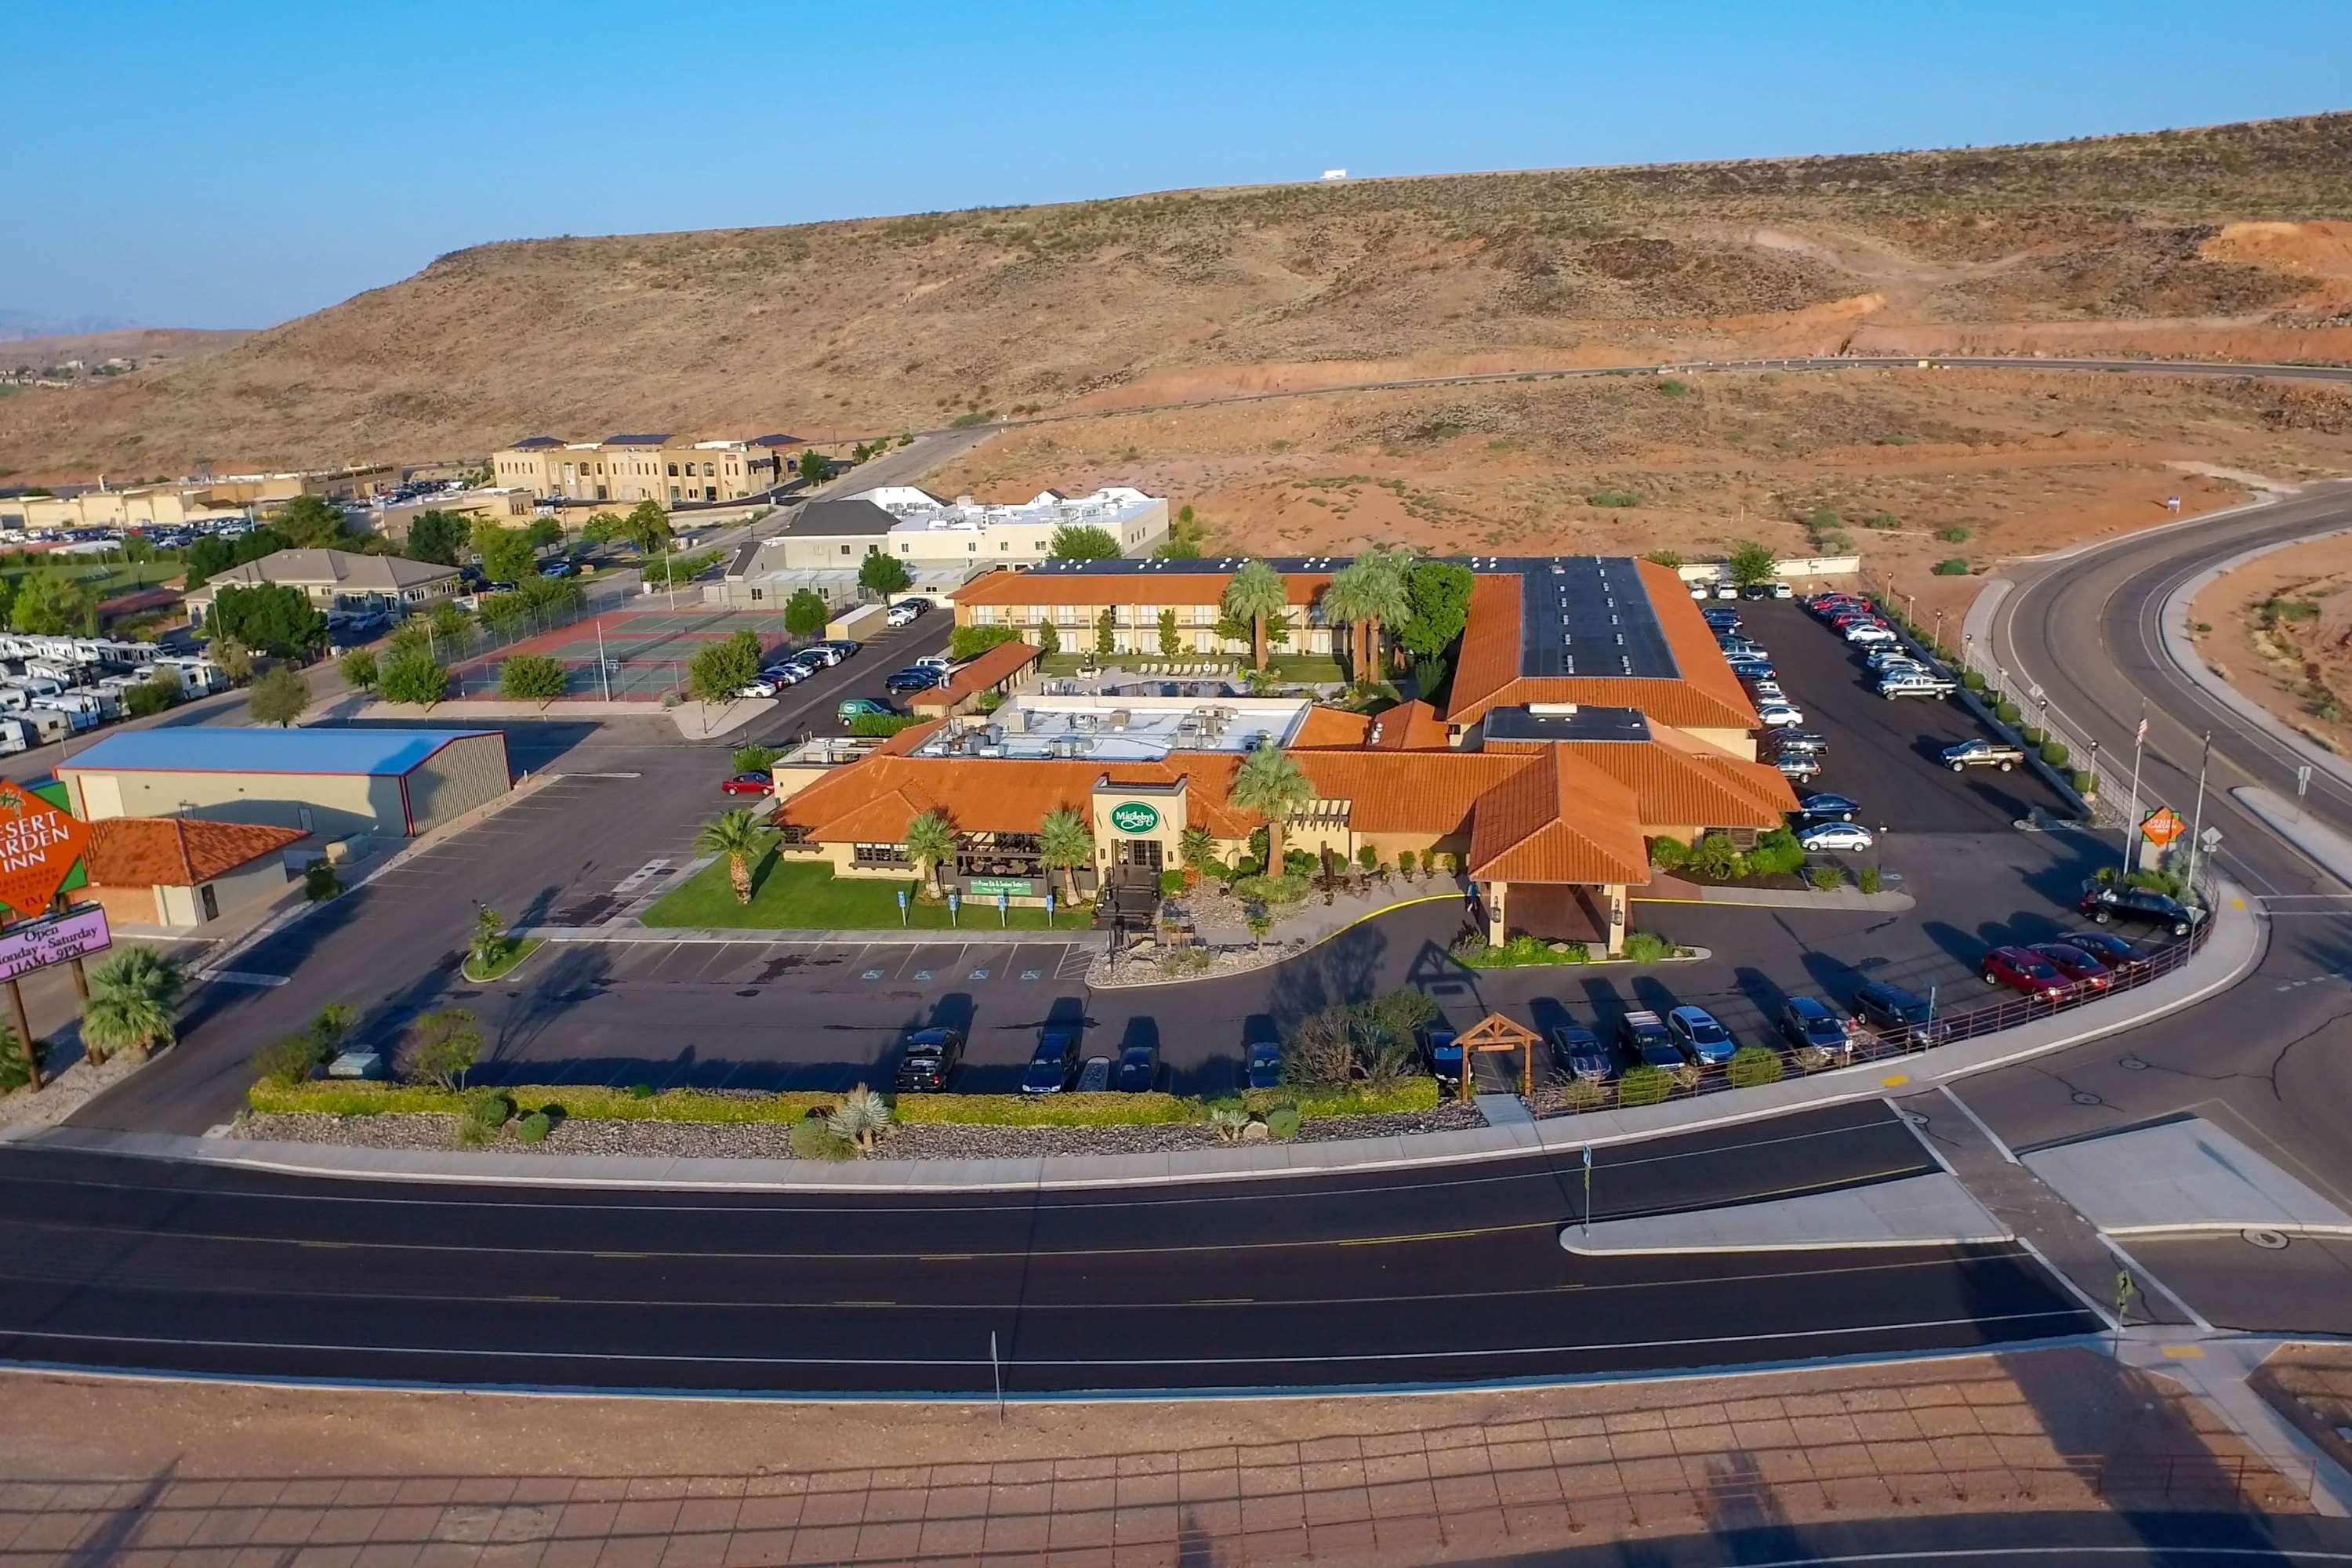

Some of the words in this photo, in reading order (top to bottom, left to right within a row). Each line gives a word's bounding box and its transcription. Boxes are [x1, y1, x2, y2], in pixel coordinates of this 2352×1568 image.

[3, 849, 45, 873] INN
[0, 946, 38, 965] onday
[47, 927, 98, 949] Saturday
[24, 926, 60, 942] Open
[9, 953, 47, 976] 11AM
[56, 942, 85, 961] 9PM
